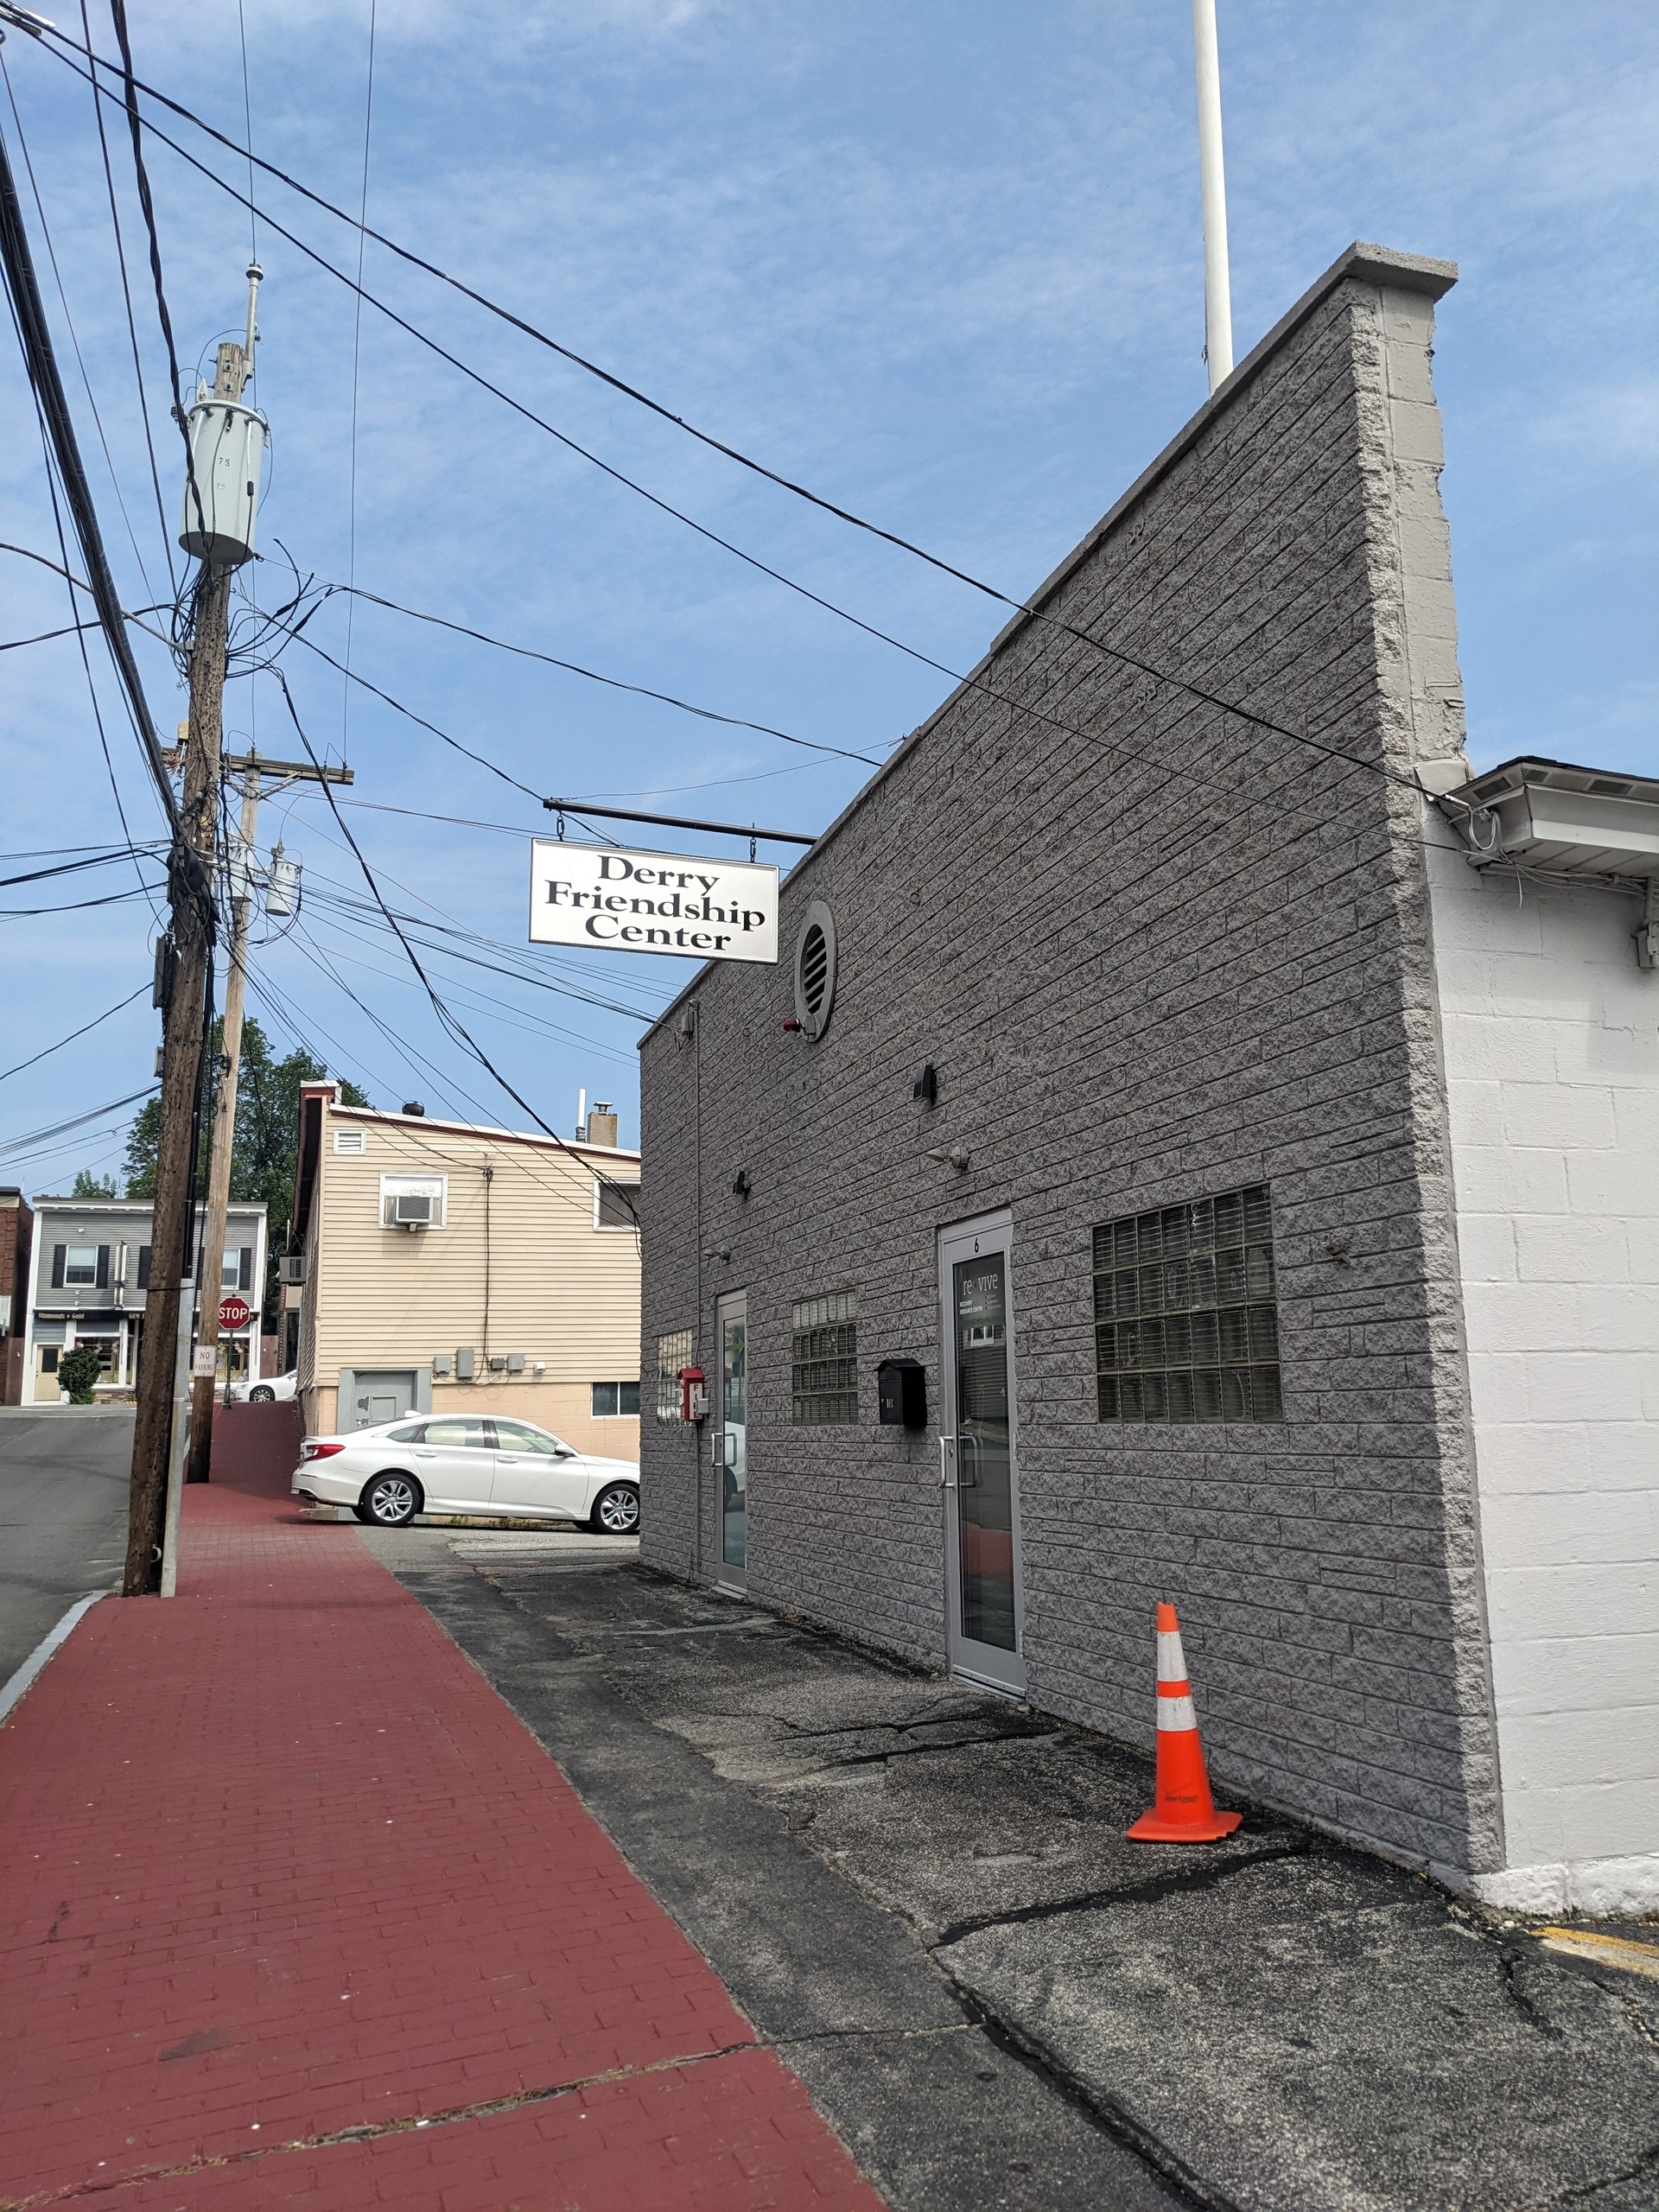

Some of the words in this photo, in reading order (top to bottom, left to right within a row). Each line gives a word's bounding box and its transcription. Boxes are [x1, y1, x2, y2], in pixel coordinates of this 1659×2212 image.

[219, 457, 231, 467] 75
[597, 855, 721, 896] Derry
[544, 880, 766, 932] Friendship
[585, 914, 732, 951] Center
[974, 1238, 979, 1253] 6
[219, 1306, 248, 1319] STOP
